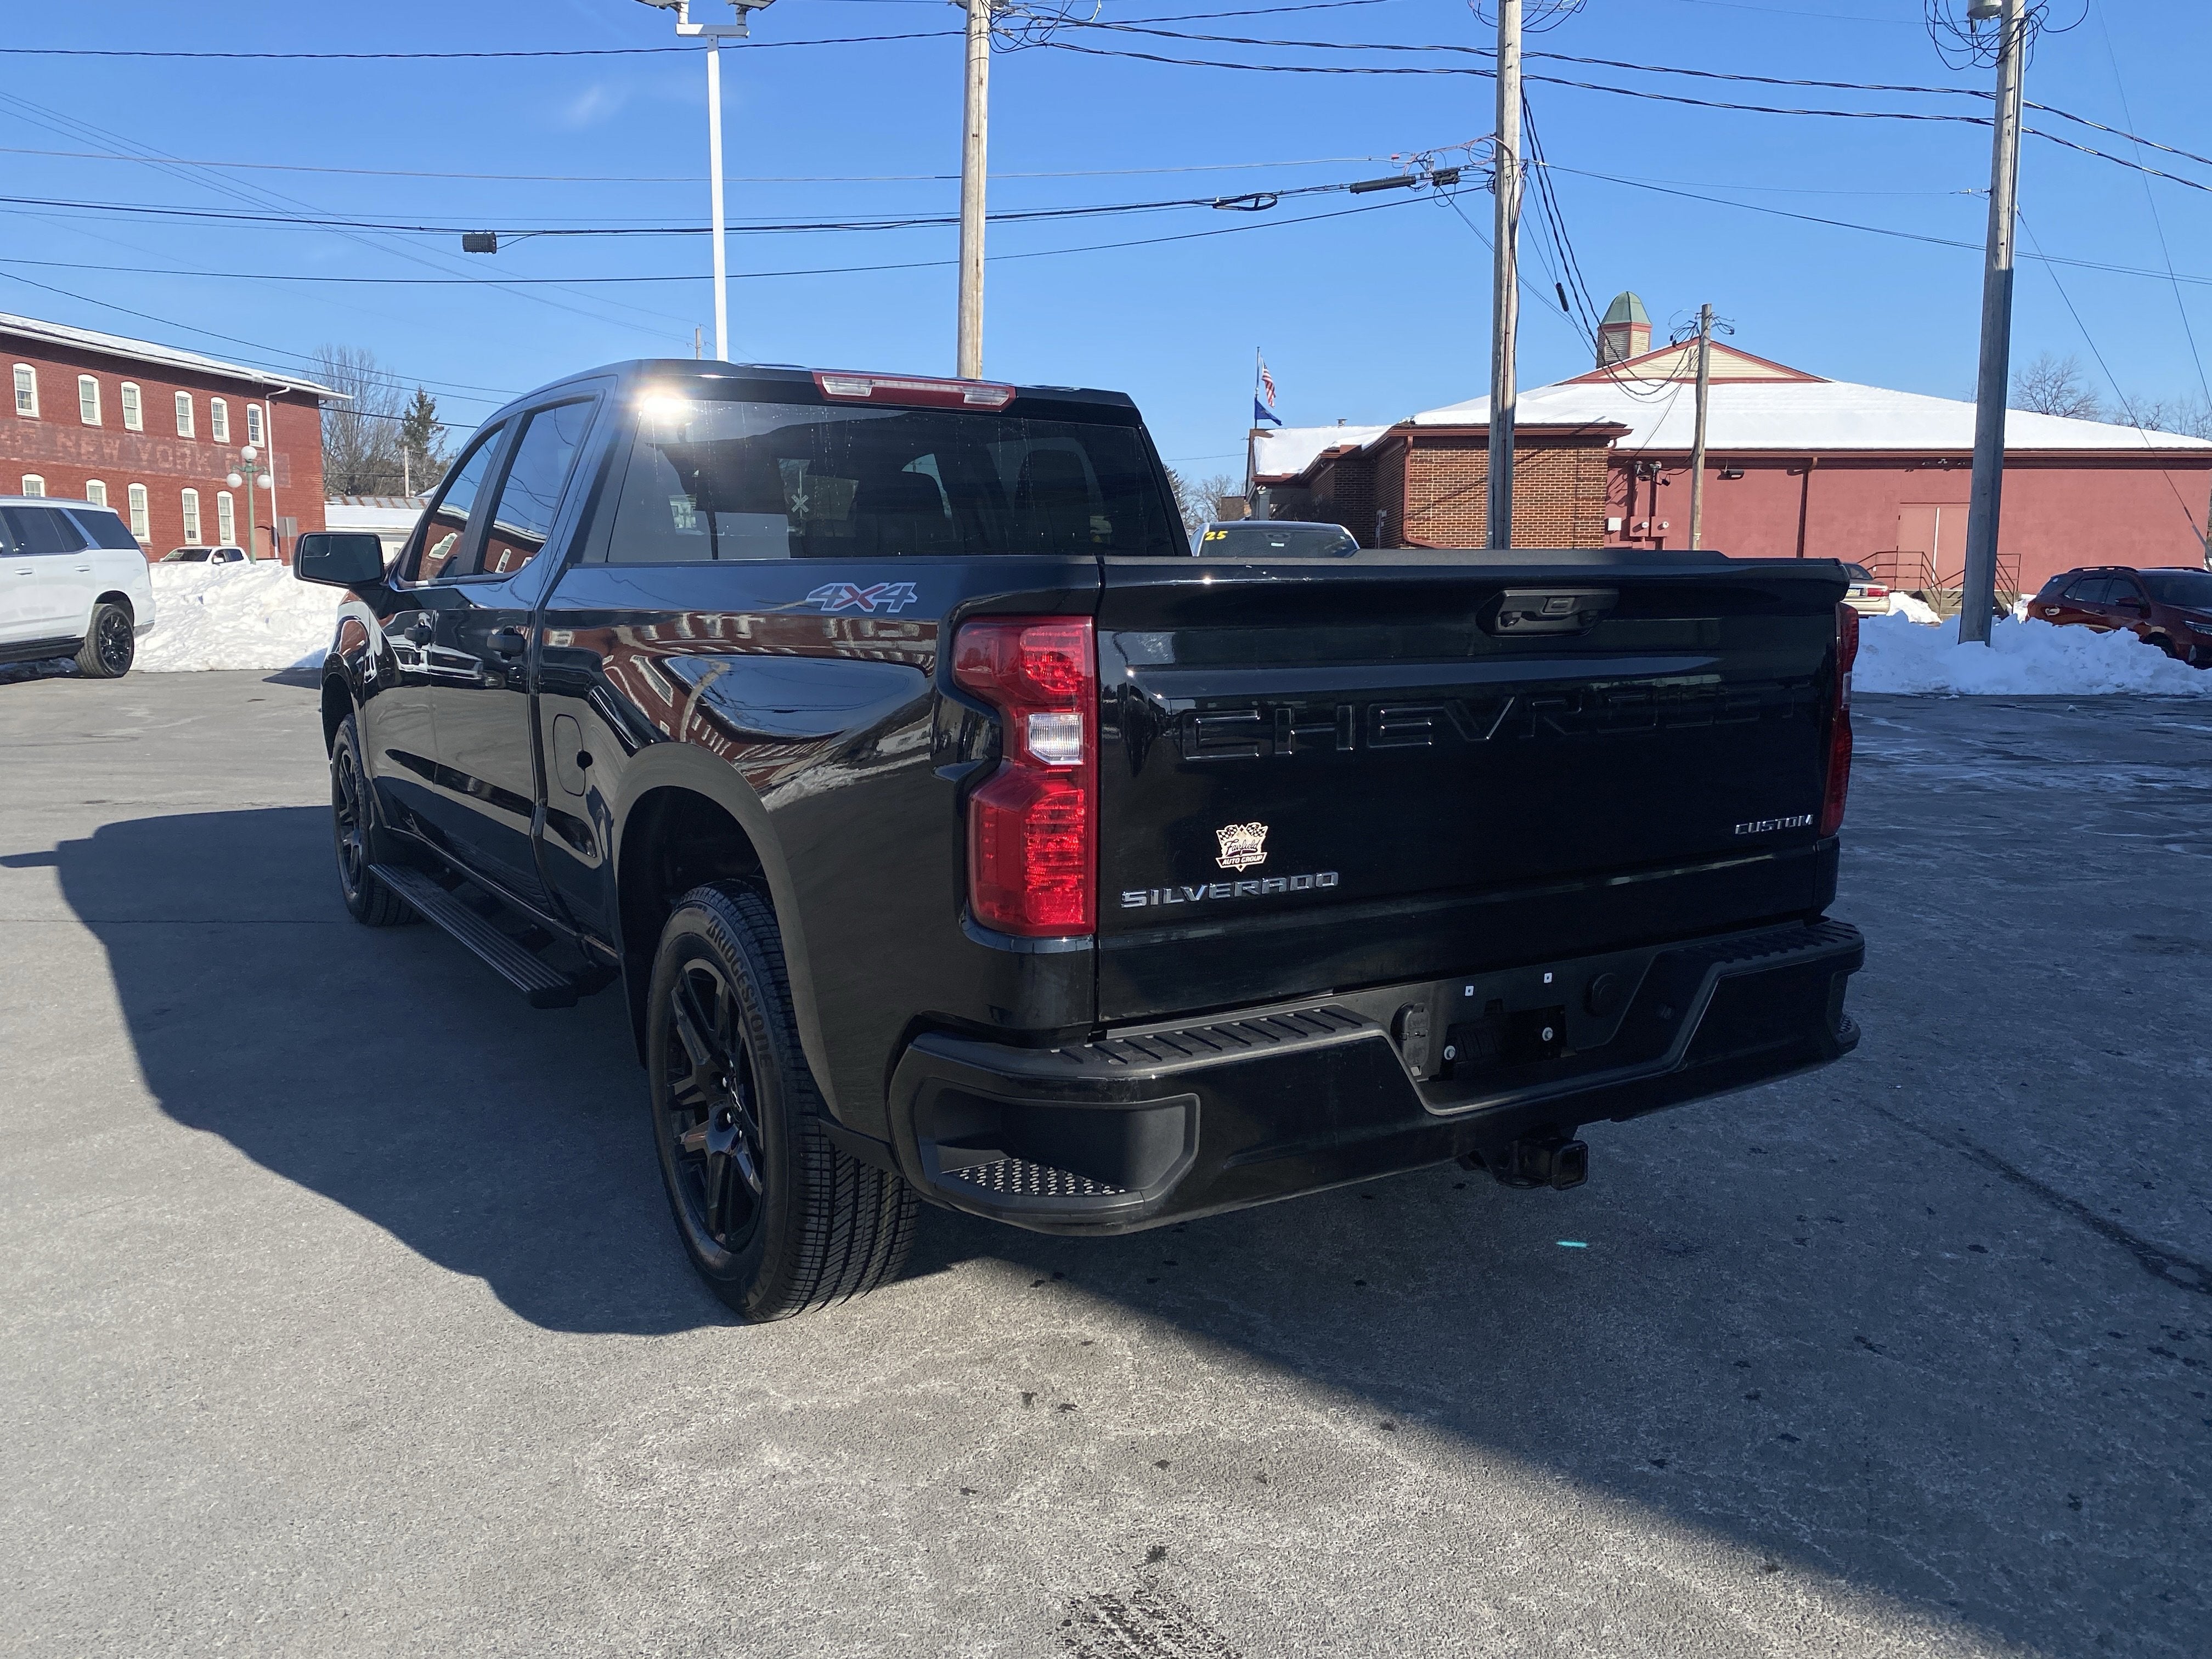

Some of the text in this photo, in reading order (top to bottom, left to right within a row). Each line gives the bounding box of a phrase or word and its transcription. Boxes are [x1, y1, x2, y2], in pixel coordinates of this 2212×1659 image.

[56, 432, 120, 462] NEW
[138, 441, 212, 472] YORK
[1205, 531, 1228, 540] 25
[1735, 814, 1813, 834] CUSTOM
[1224, 839, 1260, 855] Fairfield
[1222, 855, 1263, 865] AUTO GROUP
[1120, 872, 1339, 908] SILVERADO
[706, 915, 771, 1068] BRIDGESTONE
